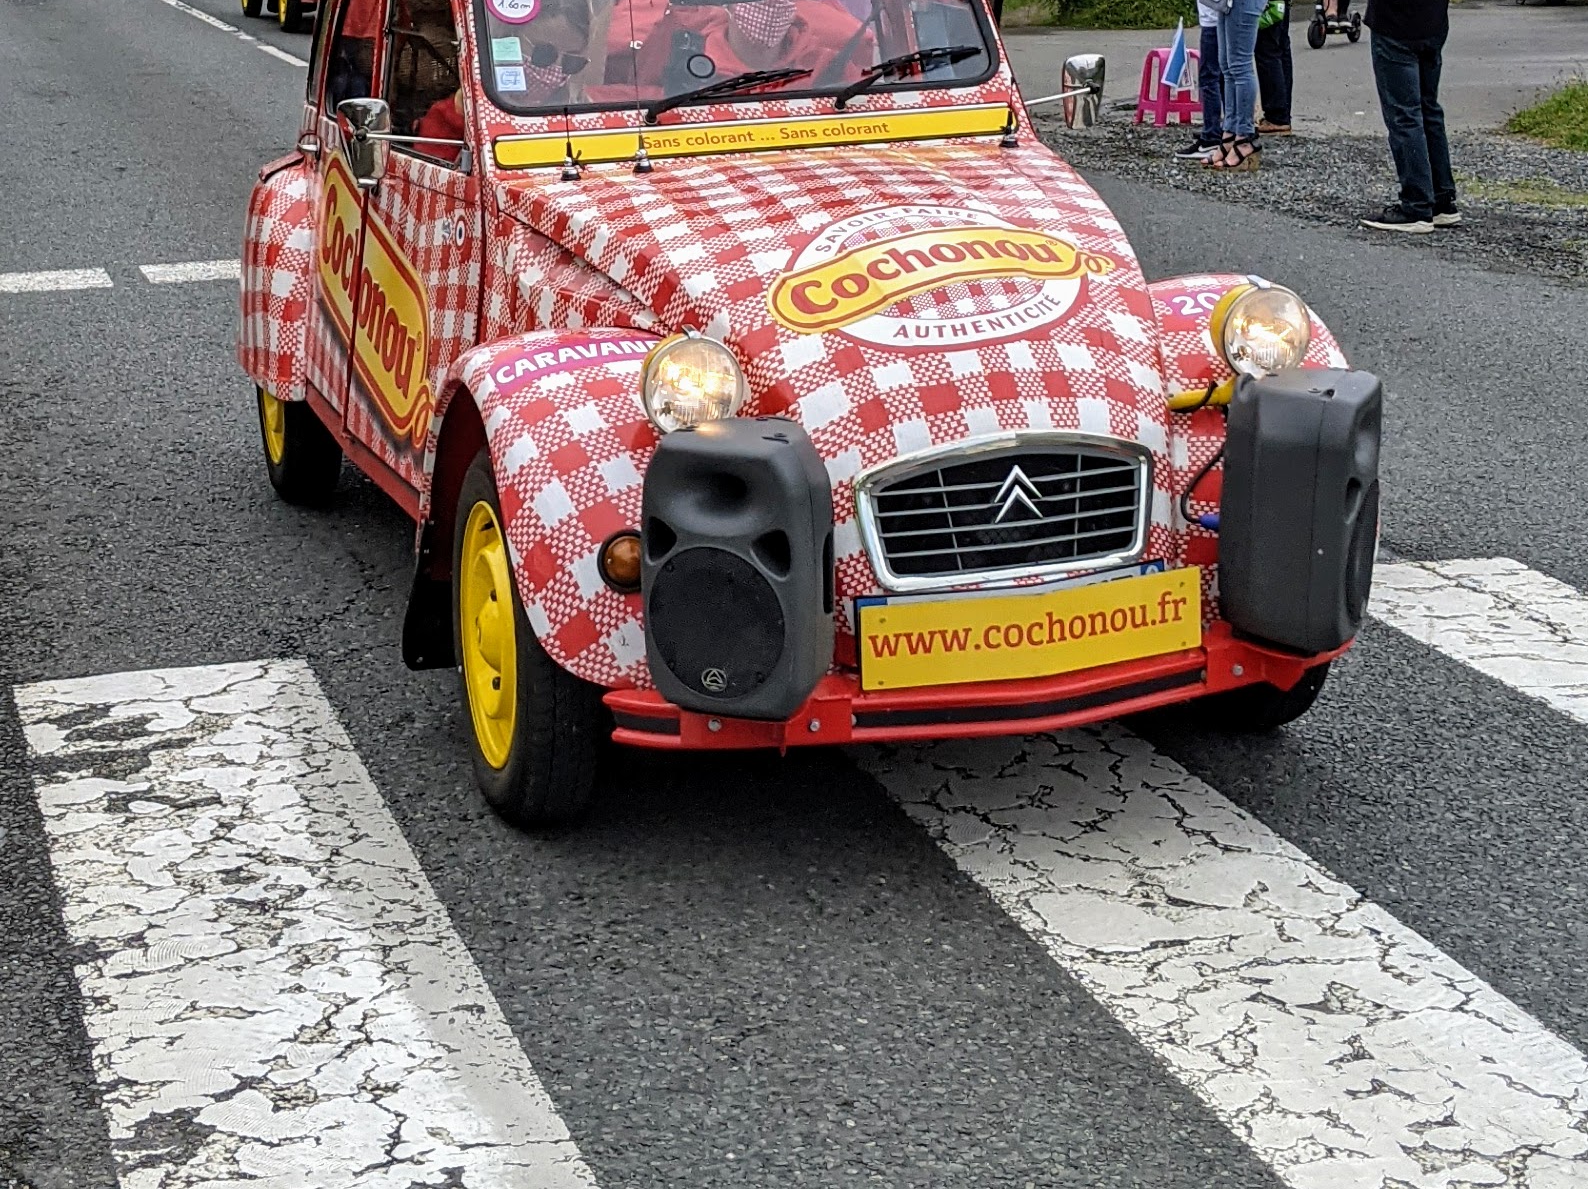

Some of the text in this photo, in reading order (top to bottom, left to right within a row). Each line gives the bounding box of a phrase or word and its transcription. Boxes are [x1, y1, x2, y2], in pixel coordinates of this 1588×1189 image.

[642, 135, 681, 150] Sans
[686, 130, 756, 147] colorant
[780, 127, 818, 140] Sans
[822, 121, 891, 138] colorant
[814, 208, 980, 253] SAVOIR-FAIRE
[790, 239, 1065, 315] Cochonou
[892, 293, 1062, 340] AUTHENTICITÉ
[1171, 290, 1227, 316] 20
[867, 590, 1188, 659] www.cochonou.fr
